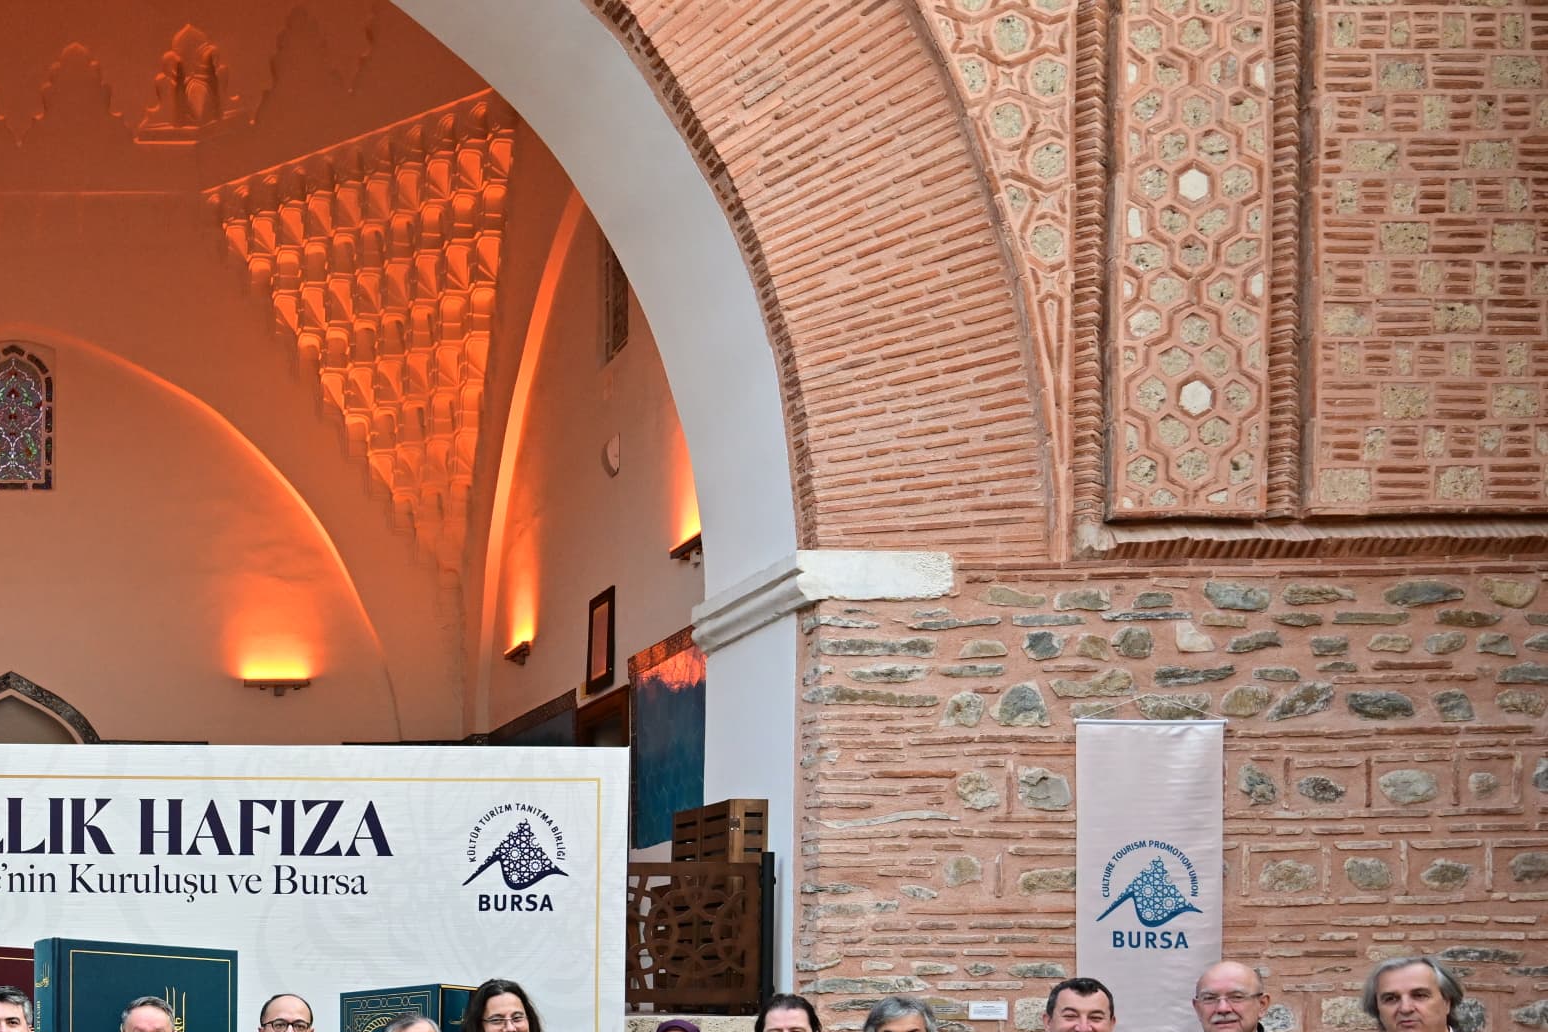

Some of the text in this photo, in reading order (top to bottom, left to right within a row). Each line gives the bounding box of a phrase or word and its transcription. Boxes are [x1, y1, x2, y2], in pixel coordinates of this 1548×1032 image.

[138, 798, 395, 857] HAFIZA
[467, 826, 482, 863] KÜLTÜR
[515, 803, 553, 826] TANITMA
[68, 863, 218, 903] Kuruluşu
[226, 874, 263, 895] ve
[272, 864, 368, 895] Bursa
[1102, 840, 1199, 898] CULTURE TOURISM PROMOTION UNION
[478, 893, 554, 912] BURSA
[1112, 930, 1189, 950] BURSA
